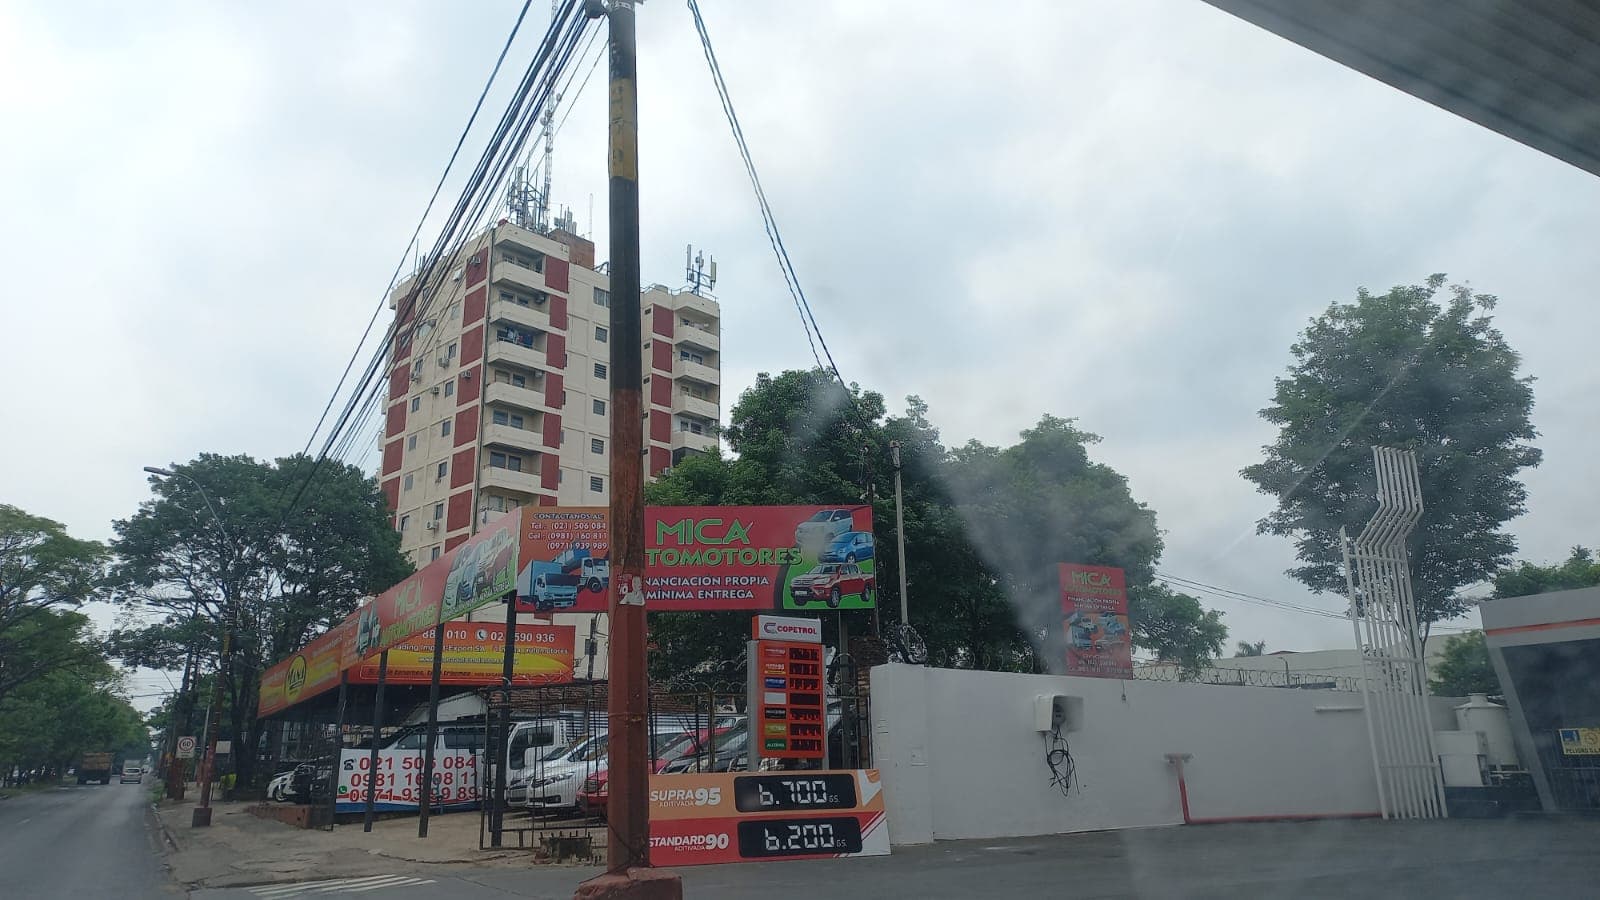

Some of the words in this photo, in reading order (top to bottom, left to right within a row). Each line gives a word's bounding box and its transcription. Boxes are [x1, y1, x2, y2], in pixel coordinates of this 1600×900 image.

[551, 522, 572, 530] (021)
[574, 522, 589, 530] 506
[591, 522, 606, 530] 084
[656, 518, 753, 545] MICA
[547, 532, 573, 541] (0981)
[575, 532, 591, 540] 160
[592, 532, 607, 540] 811
[547, 542, 573, 550] (0971)
[575, 542, 590, 550] 939
[592, 542, 608, 550] 989
[645, 547, 803, 567] TOMOTORES
[725, 574, 769, 586] PROPIA
[646, 588, 694, 600] MÍNIMA
[697, 590, 754, 600] ENTREGA
[446, 630, 467, 640] 010
[777, 625, 817, 635] COPETROL
[514, 632, 533, 642] 590
[536, 633, 555, 643] 936
[443, 756, 476, 770] 084
[351, 773, 395, 787] 0981
[758, 780, 828, 806] 6.700
[660, 800, 695, 808] ADITIVADA
[764, 823, 835, 850] 6.200
